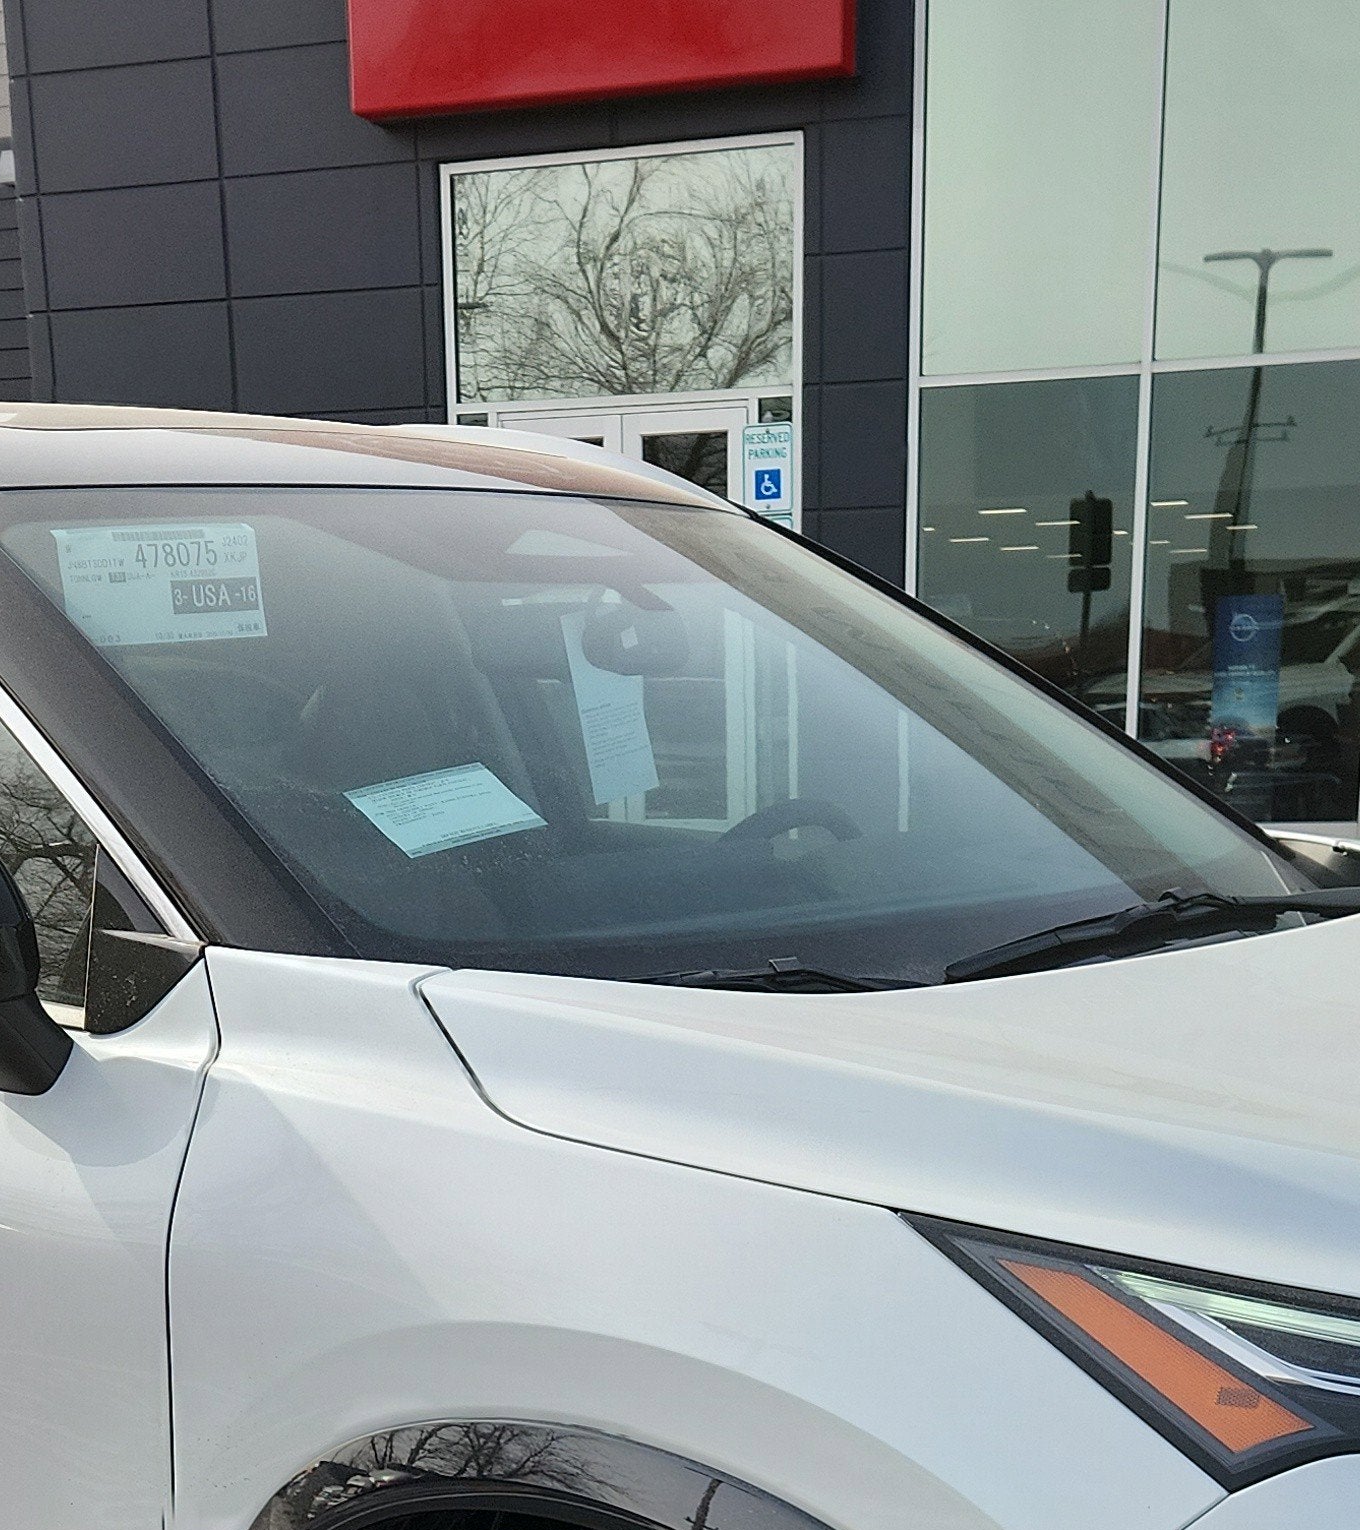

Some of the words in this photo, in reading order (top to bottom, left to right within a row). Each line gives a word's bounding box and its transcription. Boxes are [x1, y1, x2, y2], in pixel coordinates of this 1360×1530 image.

[745, 432, 790, 444] RESERVED
[748, 446, 787, 460] PARKING
[135, 540, 218, 569] 478075
[192, 583, 232, 607] USA
